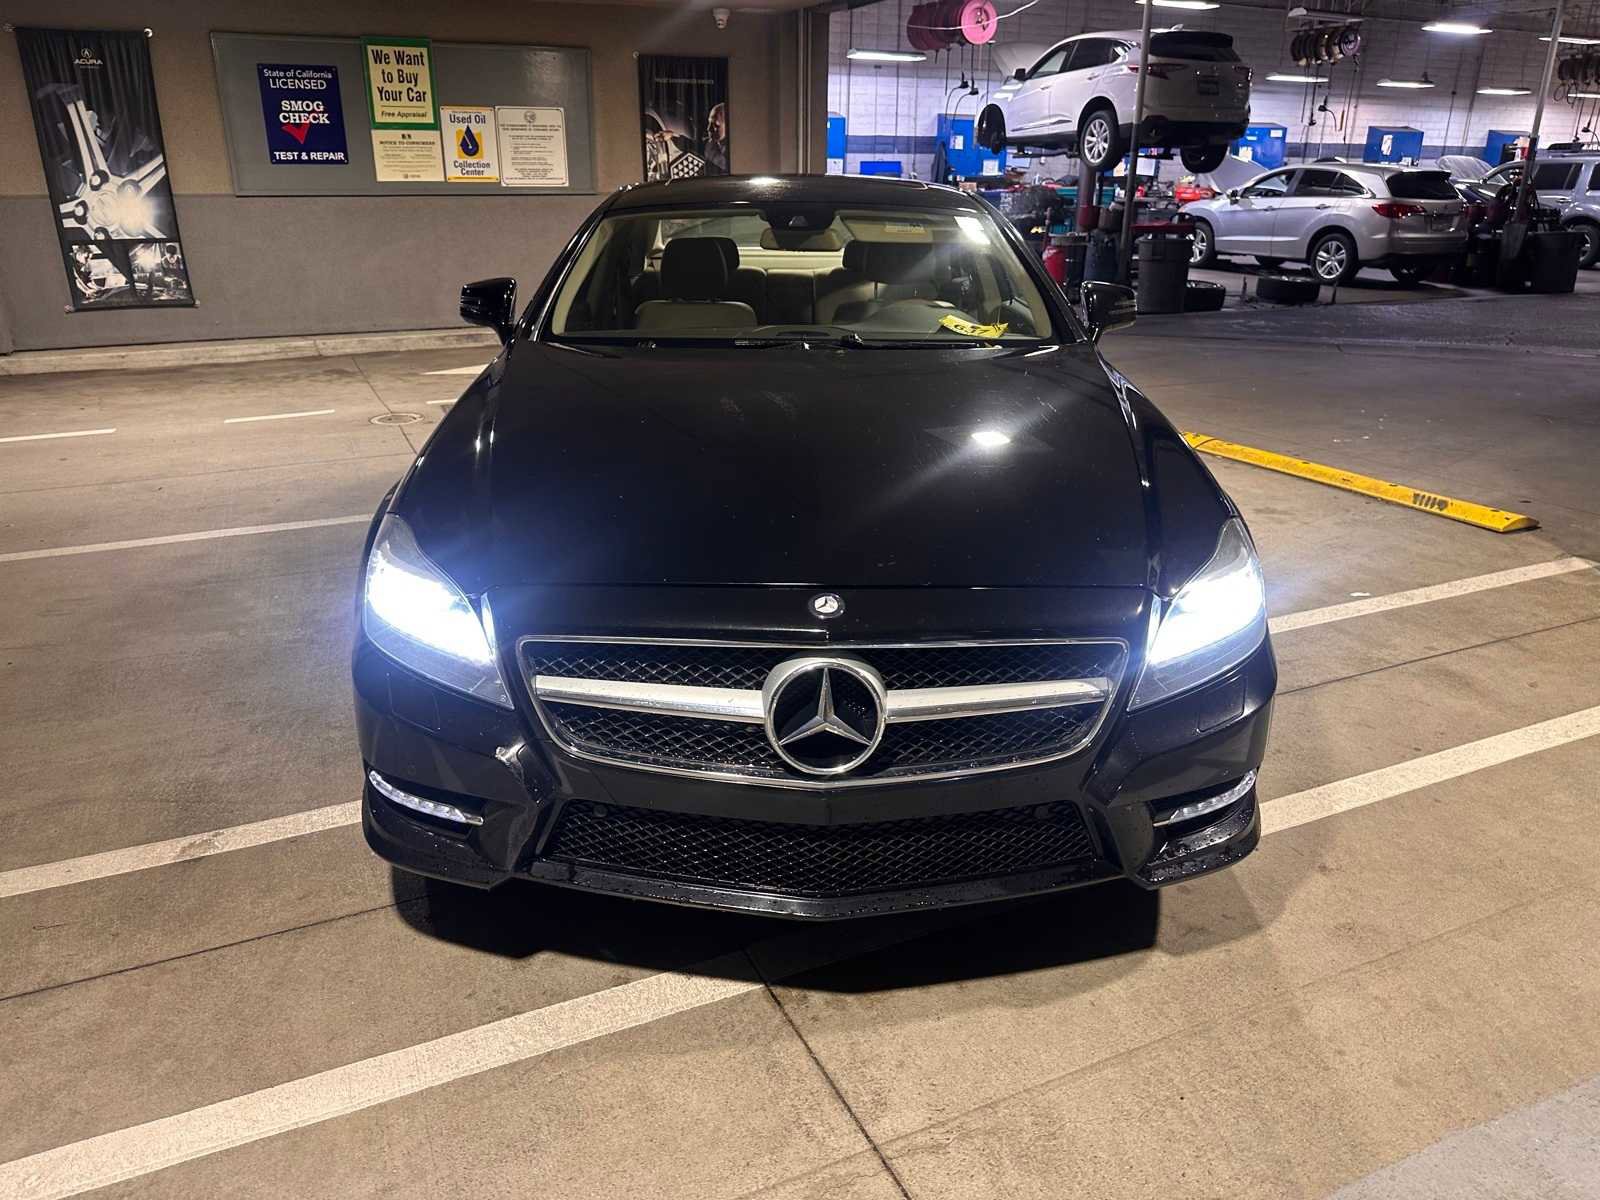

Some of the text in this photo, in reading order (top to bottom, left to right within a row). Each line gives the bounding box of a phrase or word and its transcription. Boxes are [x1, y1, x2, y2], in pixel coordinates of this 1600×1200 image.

[371, 49, 425, 66] We Want
[263, 69, 332, 79] State of California
[381, 69, 419, 87] to Buy
[269, 78, 327, 90] LICENSED
[377, 86, 427, 103] Your Car
[281, 100, 325, 112] SMOG
[279, 112, 331, 124] CHECK
[397, 111, 427, 119] Appraisal
[449, 114, 487, 124] Used Oil
[273, 151, 345, 161] TEST & REPAIR
[453, 160, 491, 169] Collection
[460, 168, 485, 176] Center
